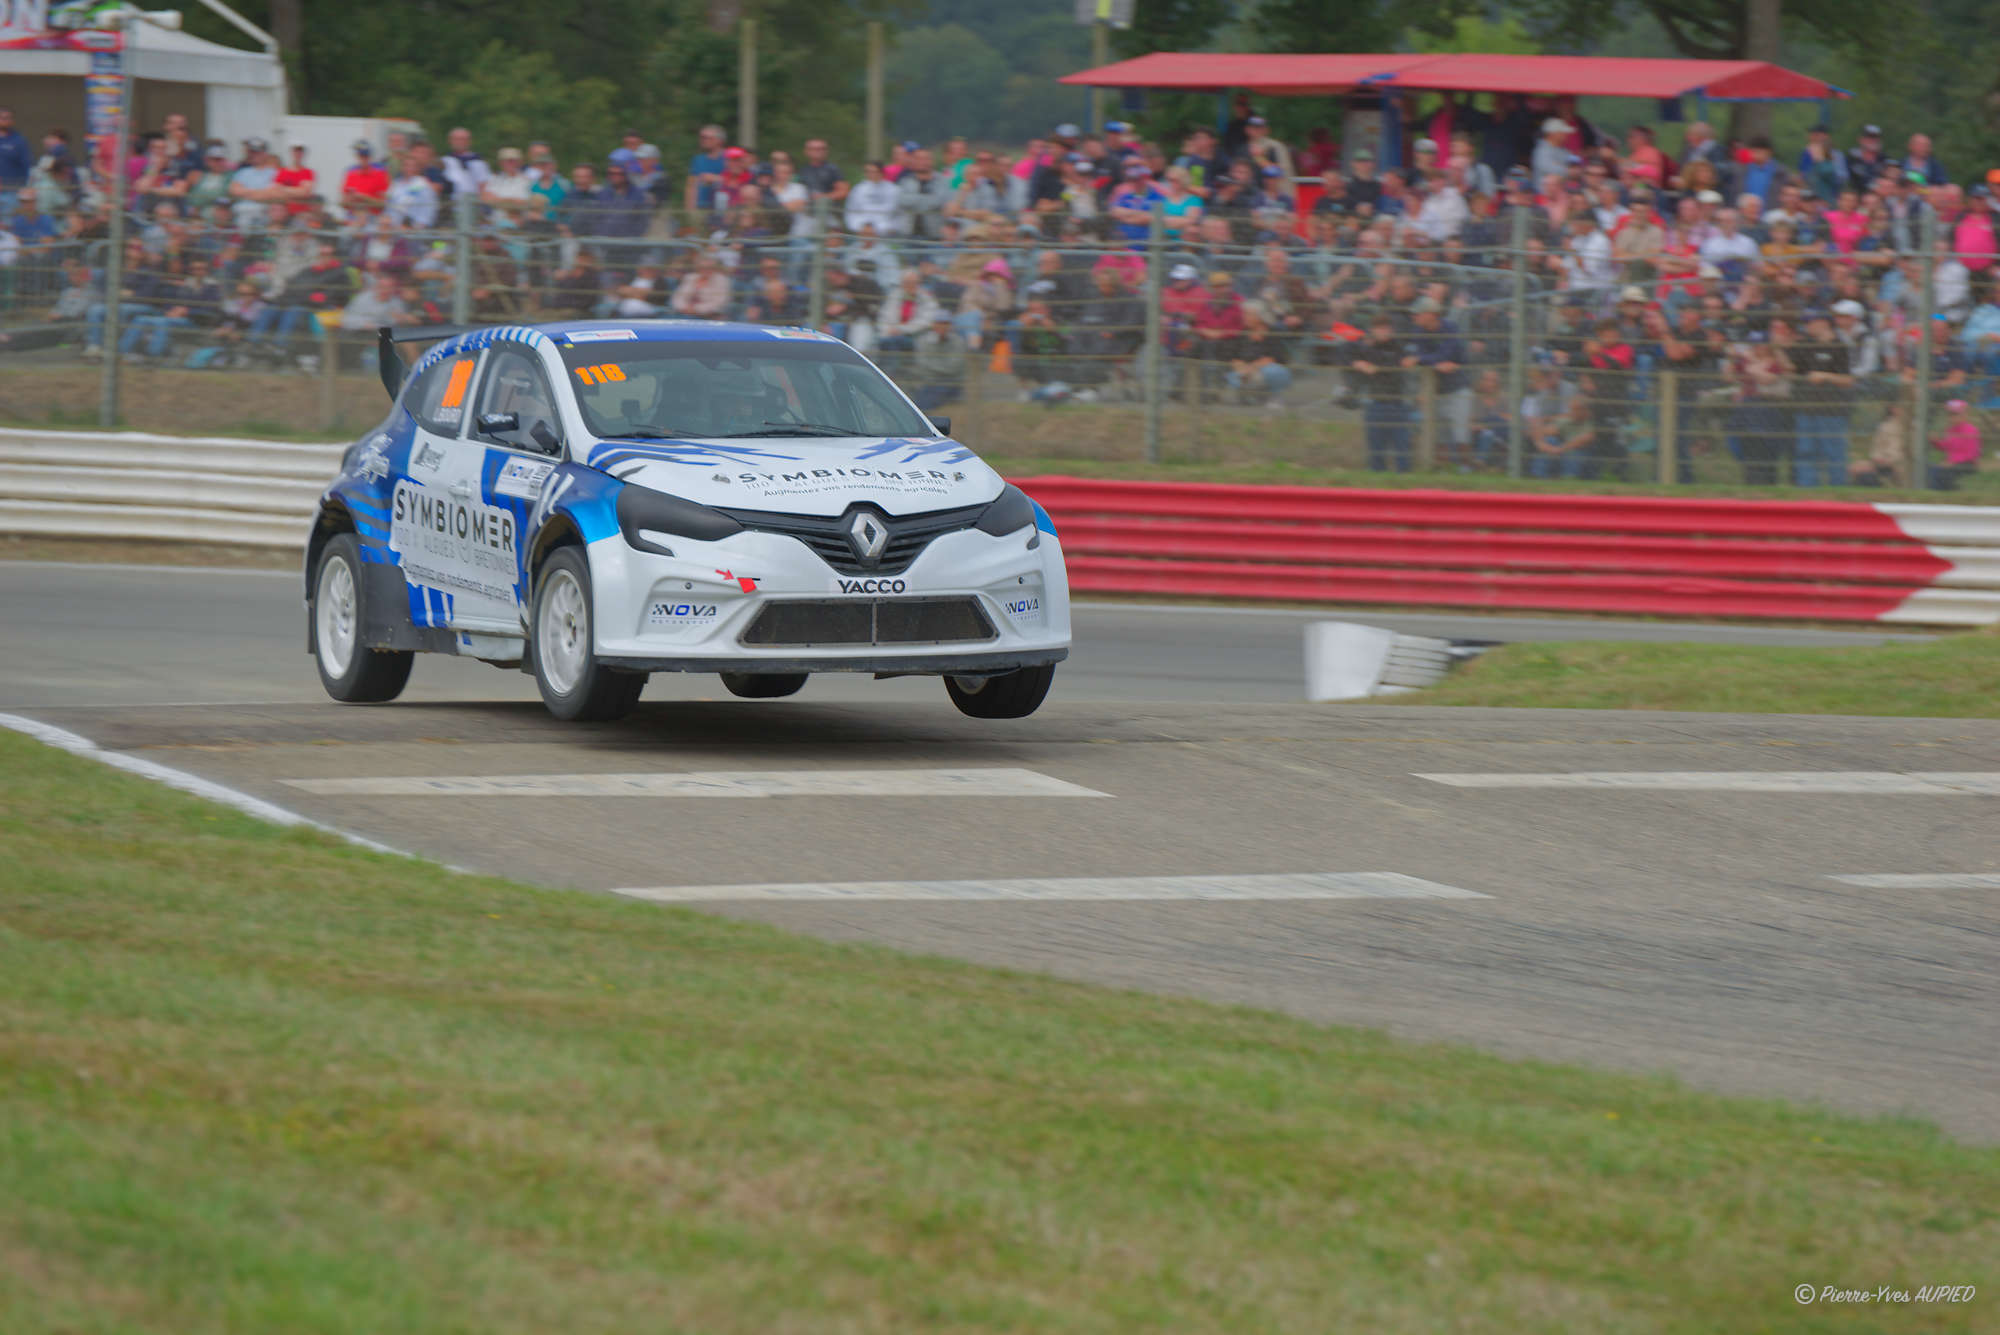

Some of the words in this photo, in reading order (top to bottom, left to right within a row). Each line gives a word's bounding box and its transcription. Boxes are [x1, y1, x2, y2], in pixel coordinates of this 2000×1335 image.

[574, 363, 627, 386] 118
[738, 468, 947, 483] SYMBIOMER
[396, 487, 513, 553] SYMBIOMER
[838, 579, 906, 594] YACCO
[656, 604, 717, 616] NOVA
[1008, 598, 1039, 613] NOVA
